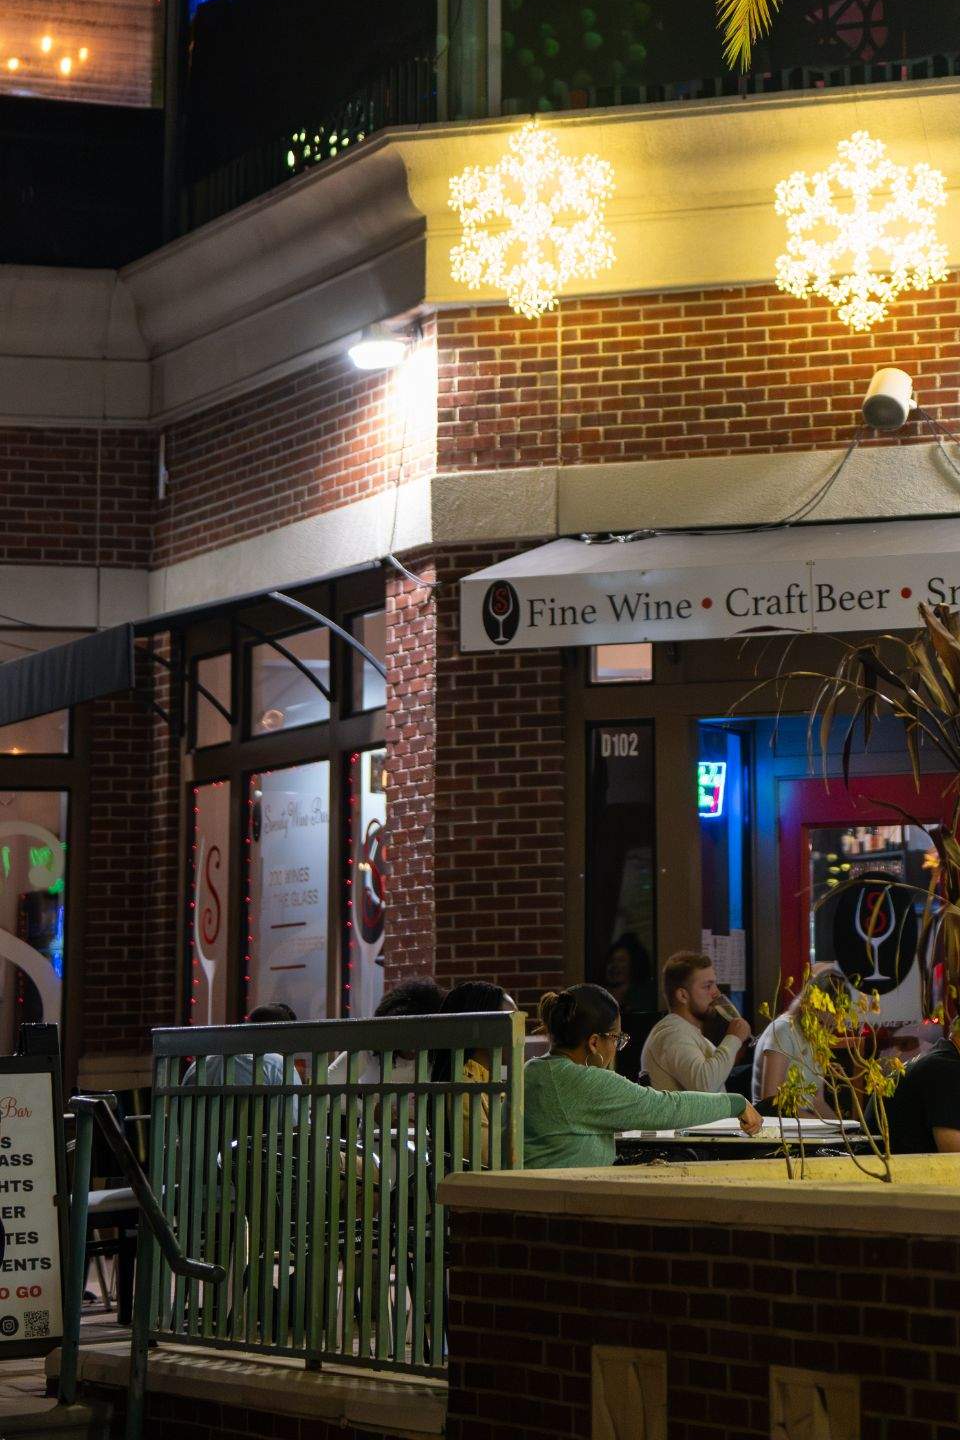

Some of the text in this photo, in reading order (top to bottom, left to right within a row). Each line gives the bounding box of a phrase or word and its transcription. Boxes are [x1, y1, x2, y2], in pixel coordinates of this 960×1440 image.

[526, 597, 597, 628] Fine
[606, 592, 692, 622] Wine
[725, 582, 808, 617] Craft
[815, 583, 890, 613] Beer
[601, 732, 639, 757] D102
[16, 1285, 42, 1299] GO
